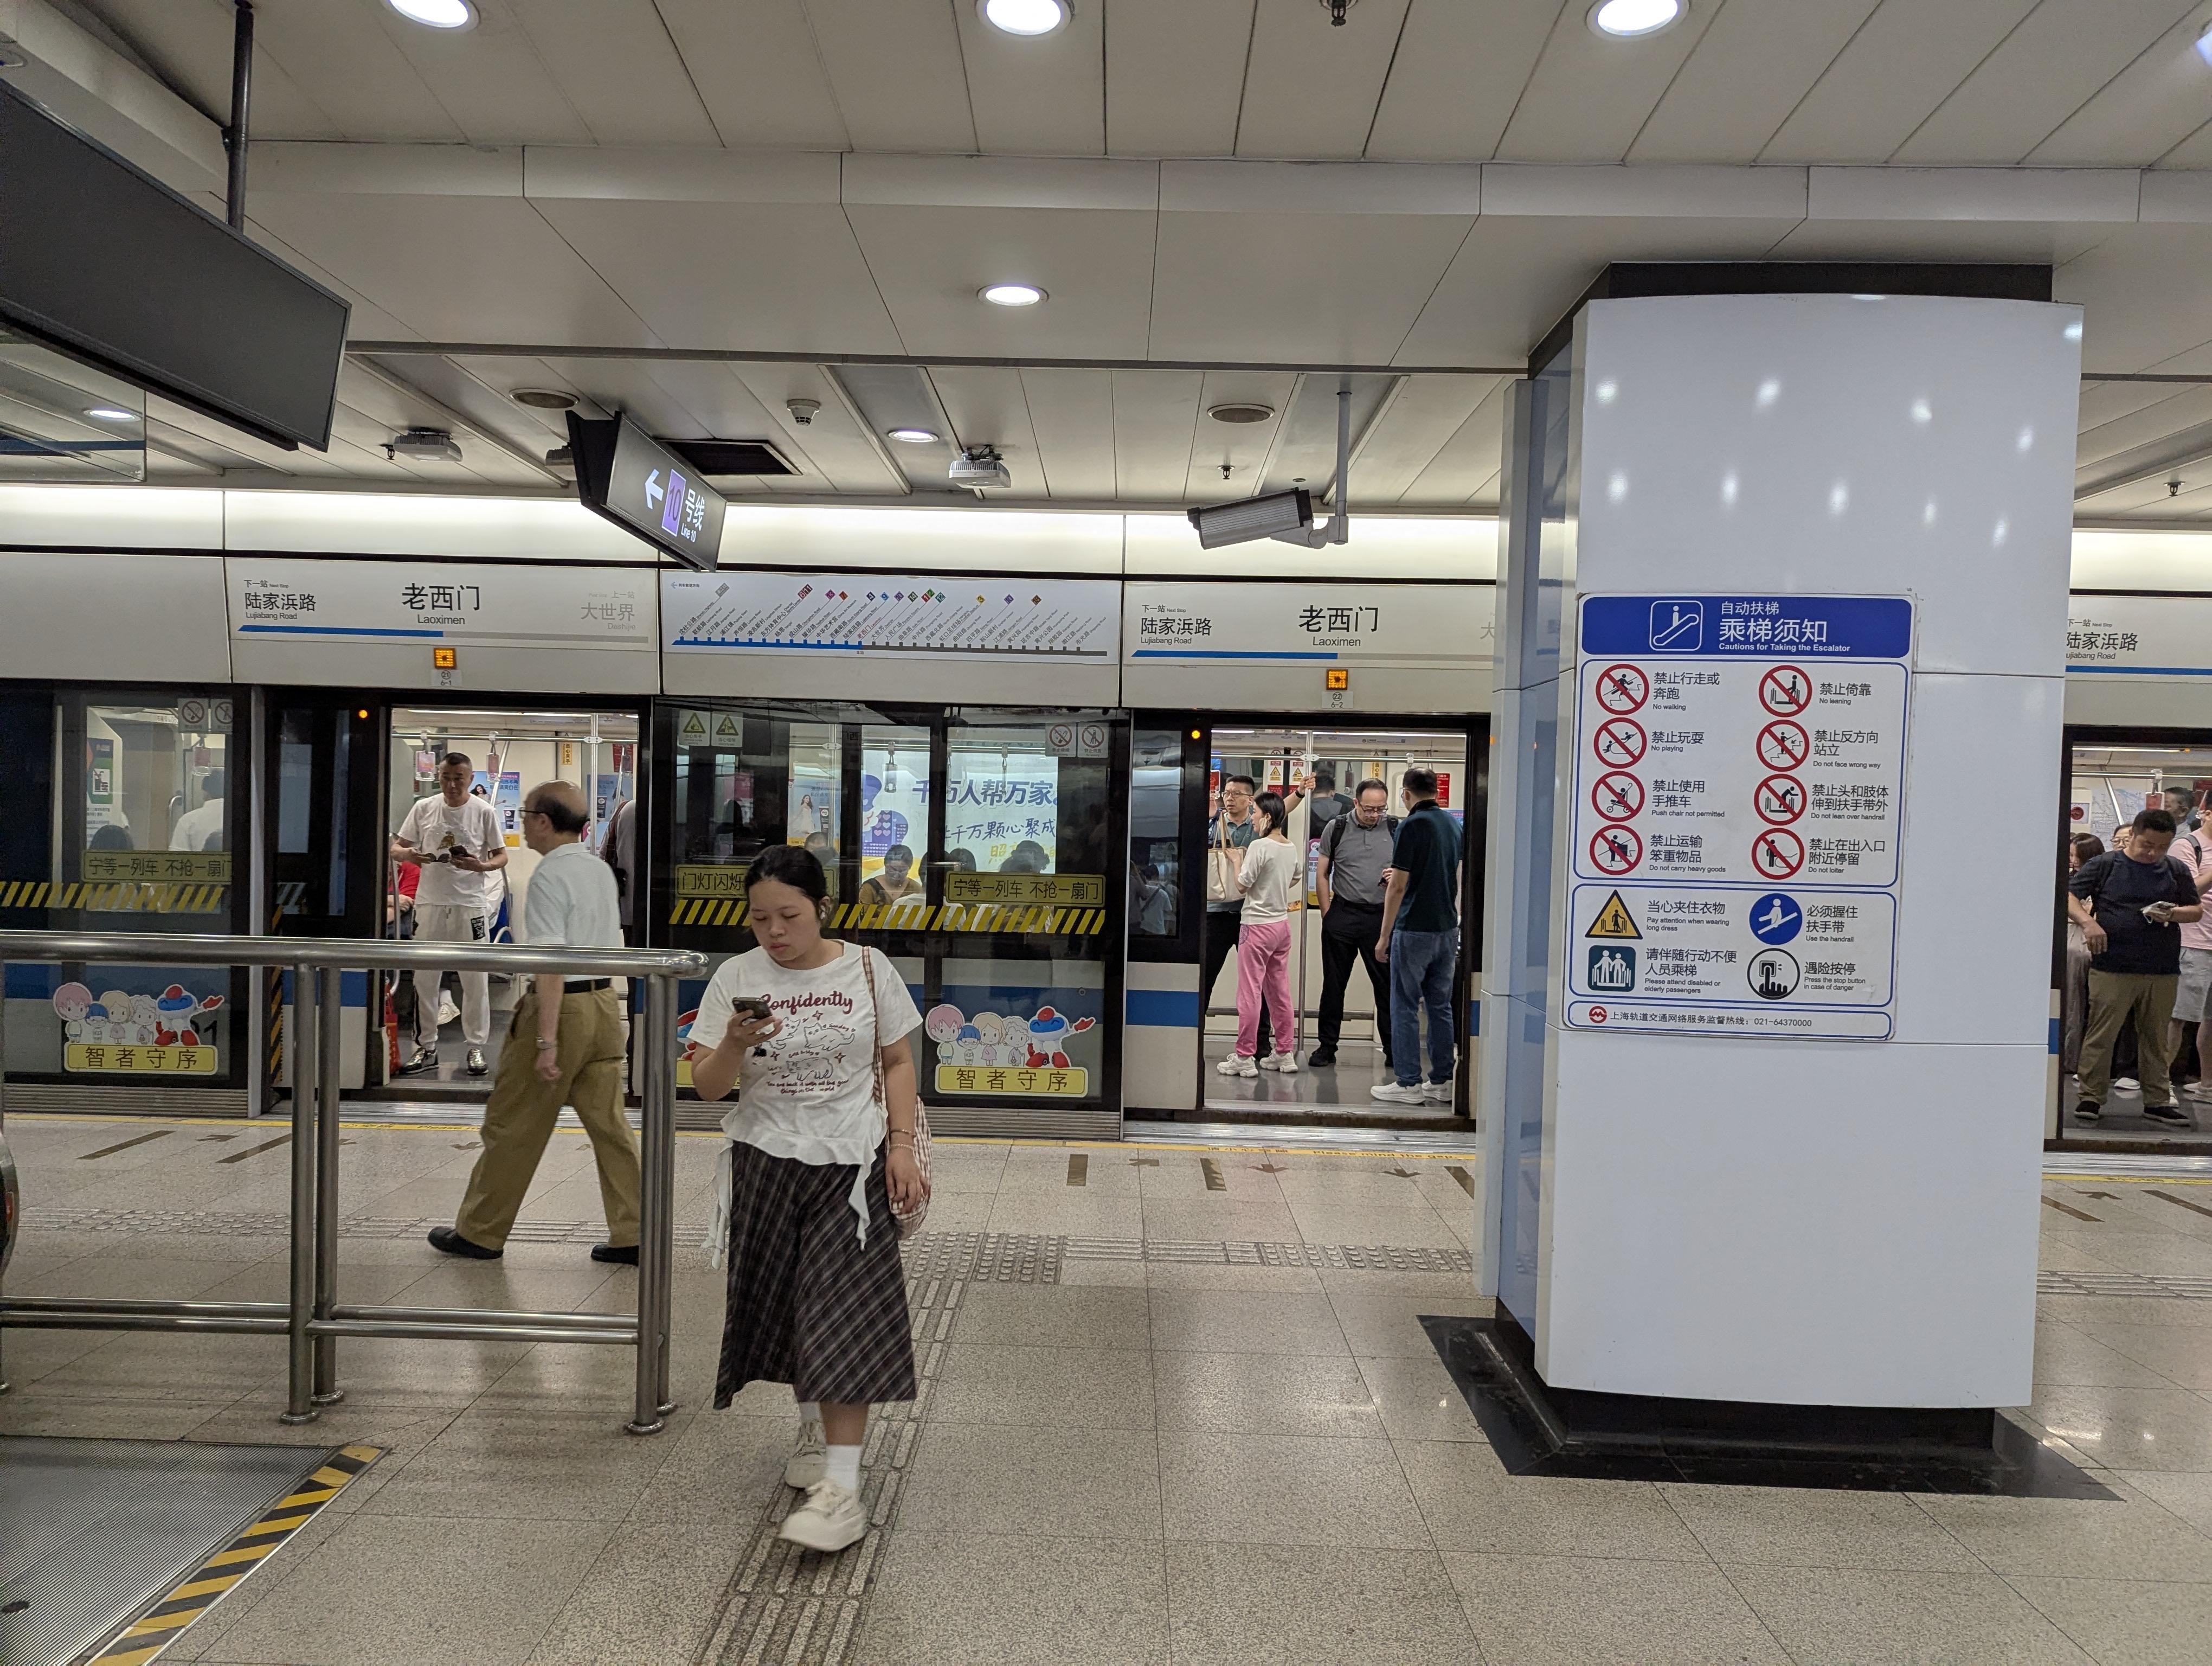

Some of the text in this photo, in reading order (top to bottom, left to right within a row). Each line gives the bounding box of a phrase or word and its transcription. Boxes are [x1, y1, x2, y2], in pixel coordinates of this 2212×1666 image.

[668, 485, 705, 531] 10 号线
[681, 523, 696, 542] Line 10
[244, 580, 268, 588] 下一站
[245, 592, 316, 611] 陆家浜路
[402, 583, 479, 611] 老西门
[581, 602, 634, 621] 大世界
[1142, 605, 1166, 613] 下一站
[1721, 601, 1779, 615] 自动扶梯
[246, 612, 278, 620] Lujiabang
[417, 614, 465, 624] Laoximen
[1298, 605, 1378, 632] 老西门
[2068, 619, 2091, 627] 下一站
[678, 617, 697, 635] 沈杜公路
[760, 612, 786, 637] 东方体育中心
[1141, 617, 1212, 636] 陆家浜路
[1719, 618, 1827, 642] 乘梯须知
[857, 625, 871, 639] 老西门
[871, 625, 885, 640] 大世界
[1141, 637, 1172, 645] Lujiabang
[1313, 637, 1361, 646] Laoximen
[1771, 644, 1797, 652] Taking
[2067, 631, 2138, 651] 陆家浜路
[2066, 652, 2095, 660] ujiabang
[1654, 672, 1720, 685] 禁止行走或
[1654, 687, 1680, 700] 奔跑
[1819, 682, 1871, 696] 禁止倚靠
[1651, 731, 1704, 744] 禁止玩耍
[1814, 729, 1878, 744] 禁止反方向
[1814, 744, 1840, 756] 站立
[1652, 779, 1705, 793] 禁止使用
[1812, 784, 1888, 798] 禁止头和肢体
[1652, 794, 1691, 808] 手推车
[1811, 798, 1888, 812] 伸到扶手带外
[1650, 834, 1702, 848] 禁止运输
[1810, 838, 1885, 852] 禁止在出入口
[1650, 849, 1701, 863] 笨重物品
[1809, 852, 1859, 865] 附近停留
[89, 857, 158, 876] 宁等一列车
[954, 879, 1098, 900] 宁等一列车 不抢一扇门
[1648, 900, 1725, 914] 当心夹住衣物
[1806, 905, 1858, 918] 必须握住
[1806, 920, 1844, 933] 扶手带
[1646, 947, 1737, 963] 请伴随行动不便
[1645, 963, 1697, 977] 人员乘梯
[1804, 962, 1855, 975] 遇险按停
[85, 1046, 197, 1069] 智者守序
[956, 1068, 1068, 1091] 智者守序
